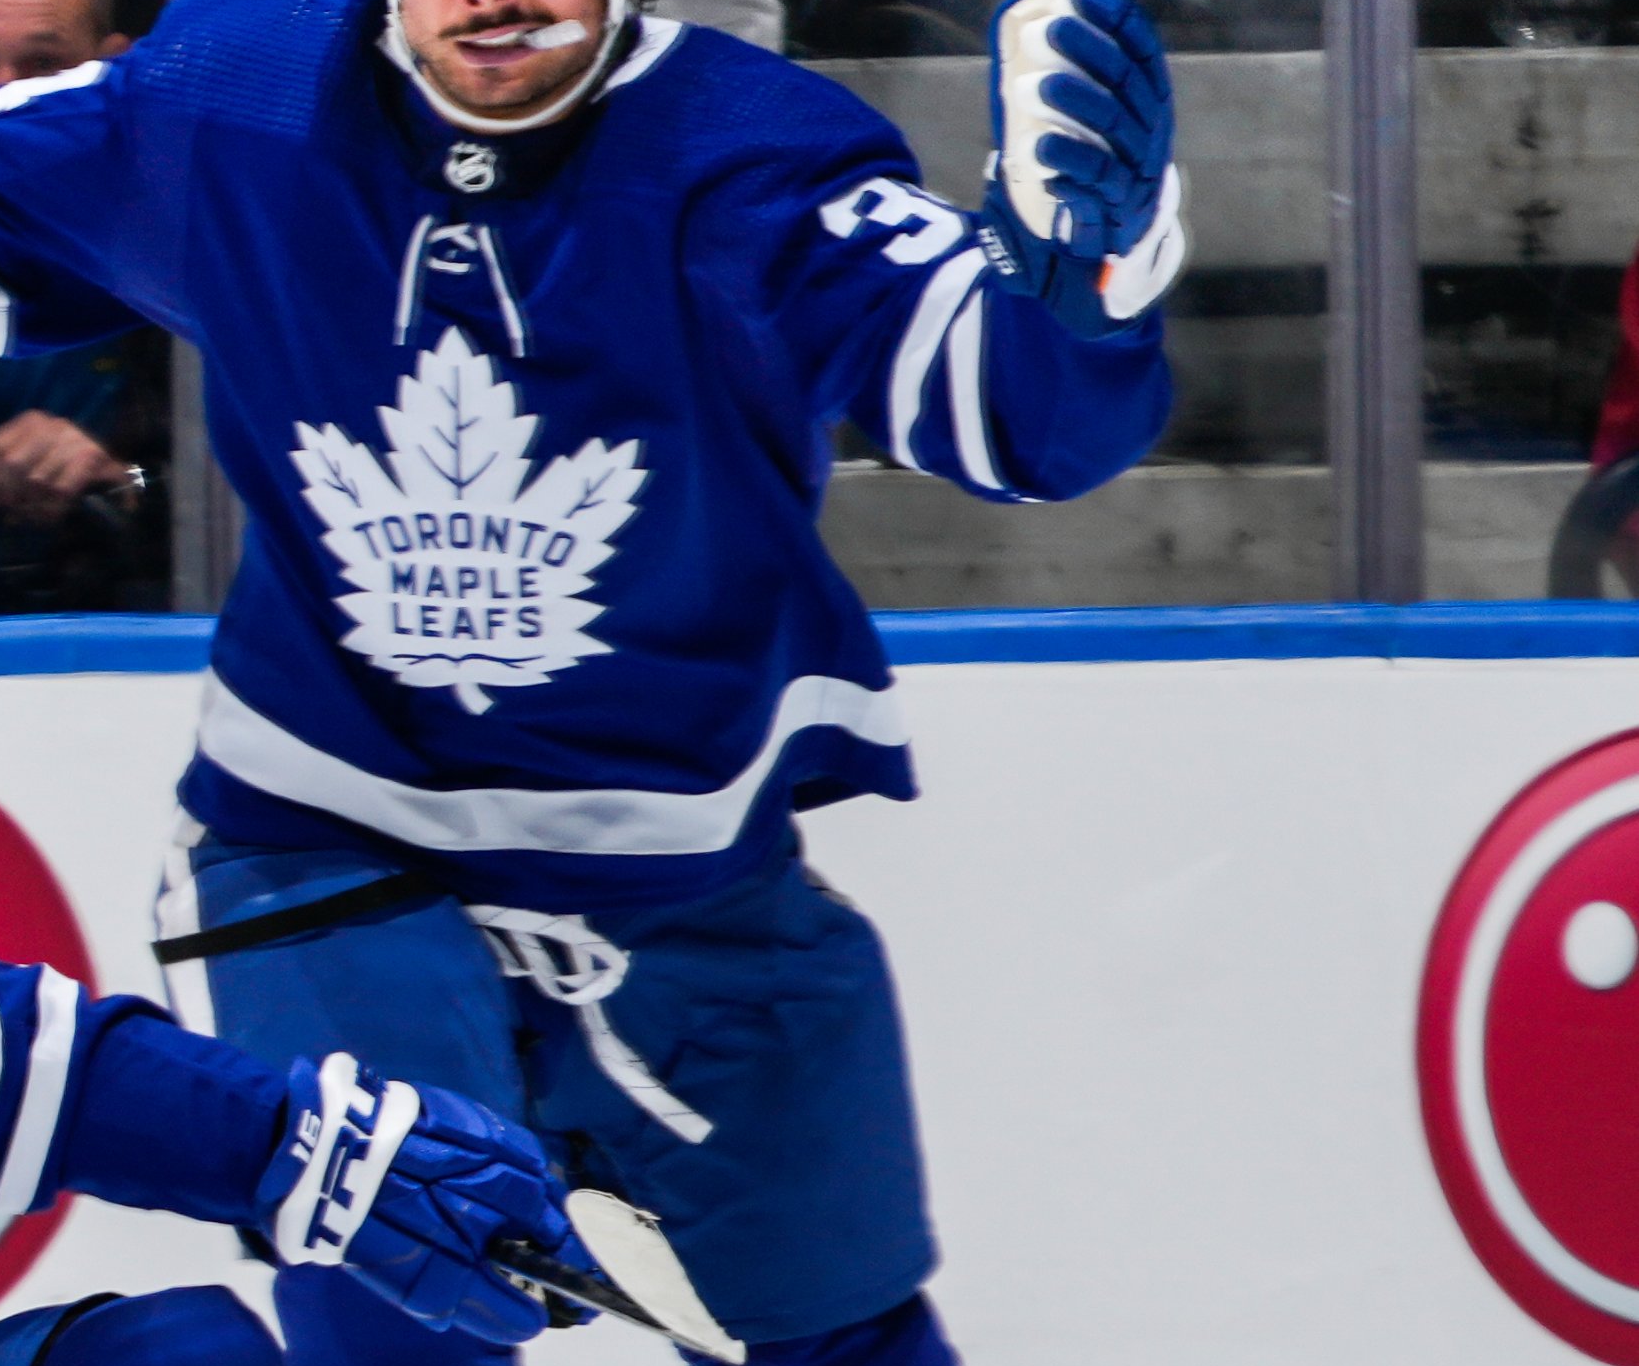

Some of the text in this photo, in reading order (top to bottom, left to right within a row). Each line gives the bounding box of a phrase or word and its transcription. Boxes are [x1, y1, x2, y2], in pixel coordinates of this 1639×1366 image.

[818, 176, 965, 266] 3
[353, 512, 578, 568] TORONTO
[390, 561, 542, 599] MAPLE
[392, 601, 544, 640] LEAFS
